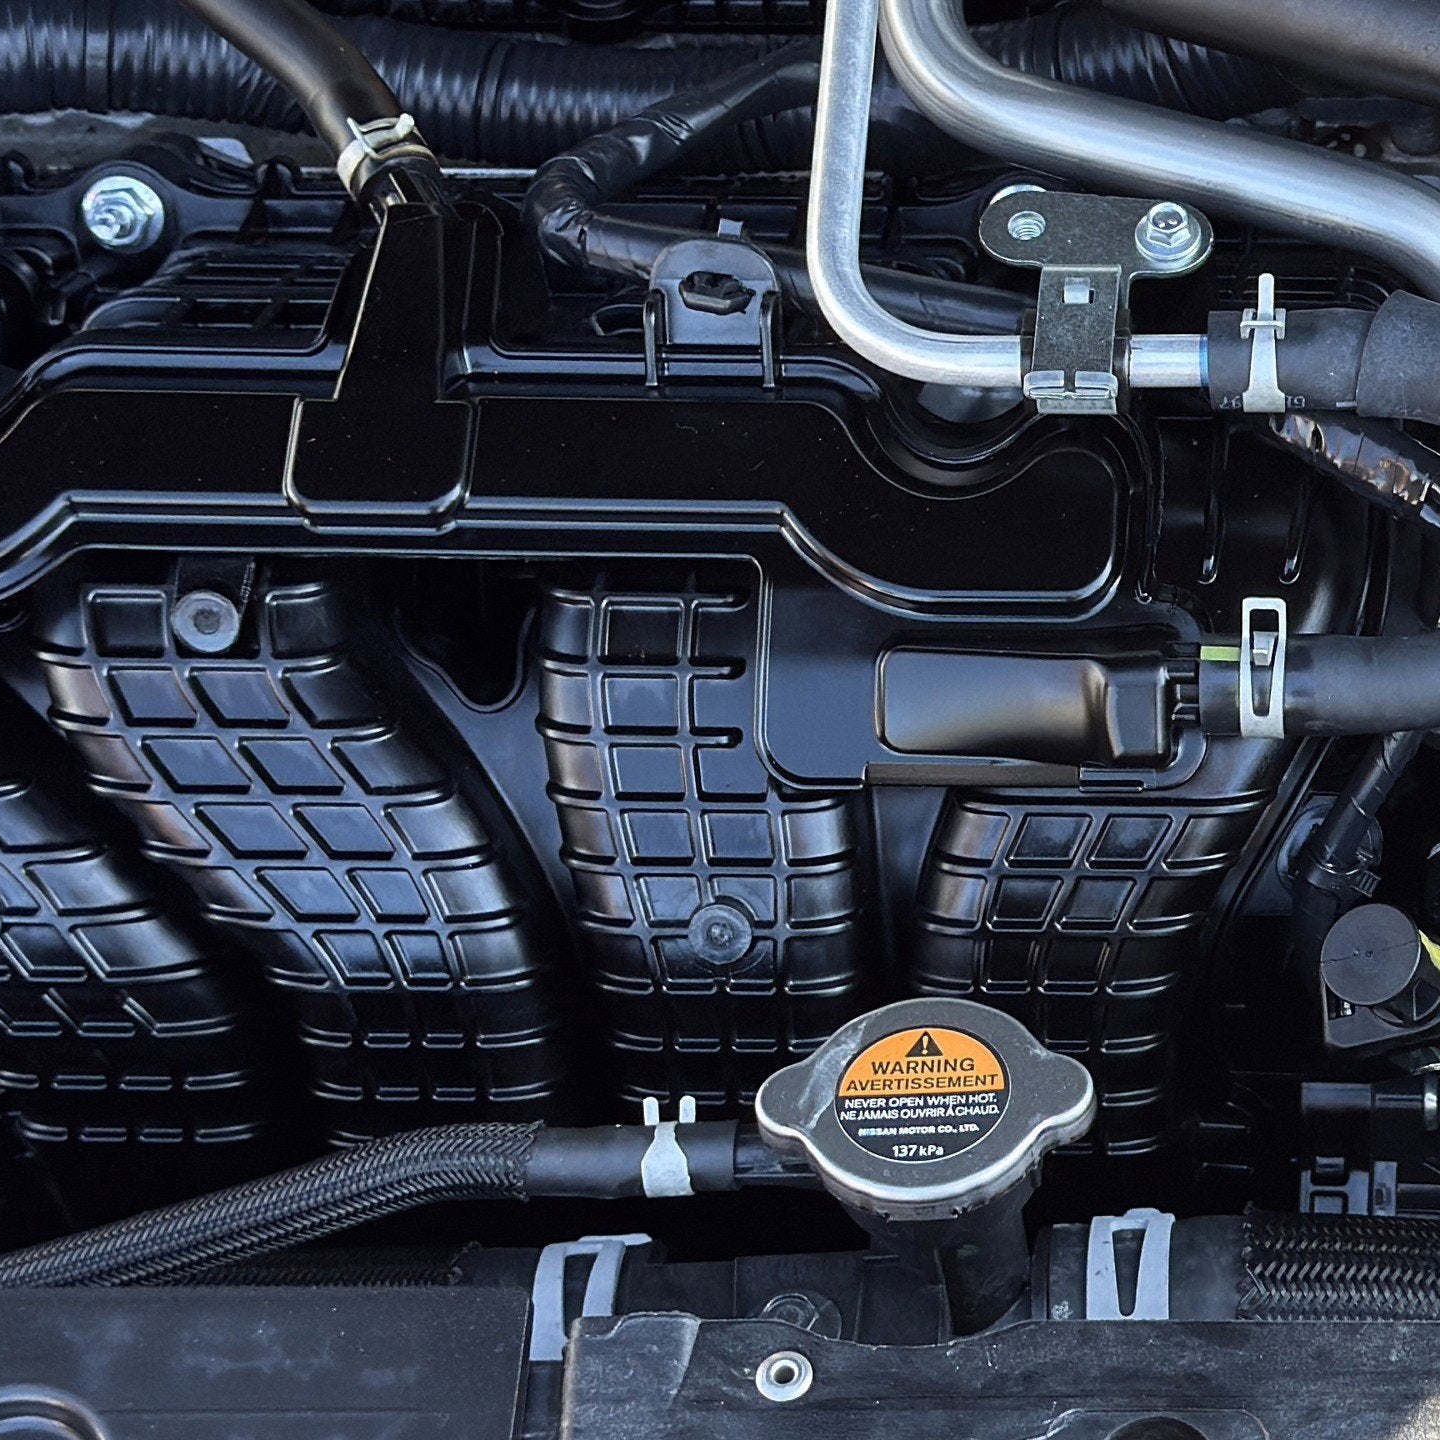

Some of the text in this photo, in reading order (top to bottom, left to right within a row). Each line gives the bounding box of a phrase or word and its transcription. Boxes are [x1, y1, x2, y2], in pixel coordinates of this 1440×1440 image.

[871, 1057, 975, 1075] WARNING
[846, 1073, 998, 1092] AVERTISSEMENT
[844, 1092, 998, 1109] NEVER OPEN WHEN HOT.
[840, 1110, 857, 1121] NE
[857, 1109, 900, 1121] JAMAIS
[900, 1107, 946, 1119] OUVRIR
[955, 1104, 1000, 1117] CHAUD.
[858, 1127, 898, 1137] NISSAN
[898, 1125, 936, 1136] MOTOR
[959, 1123, 980, 1133] LTD.
[892, 1144, 945, 1158] 137 kPa
